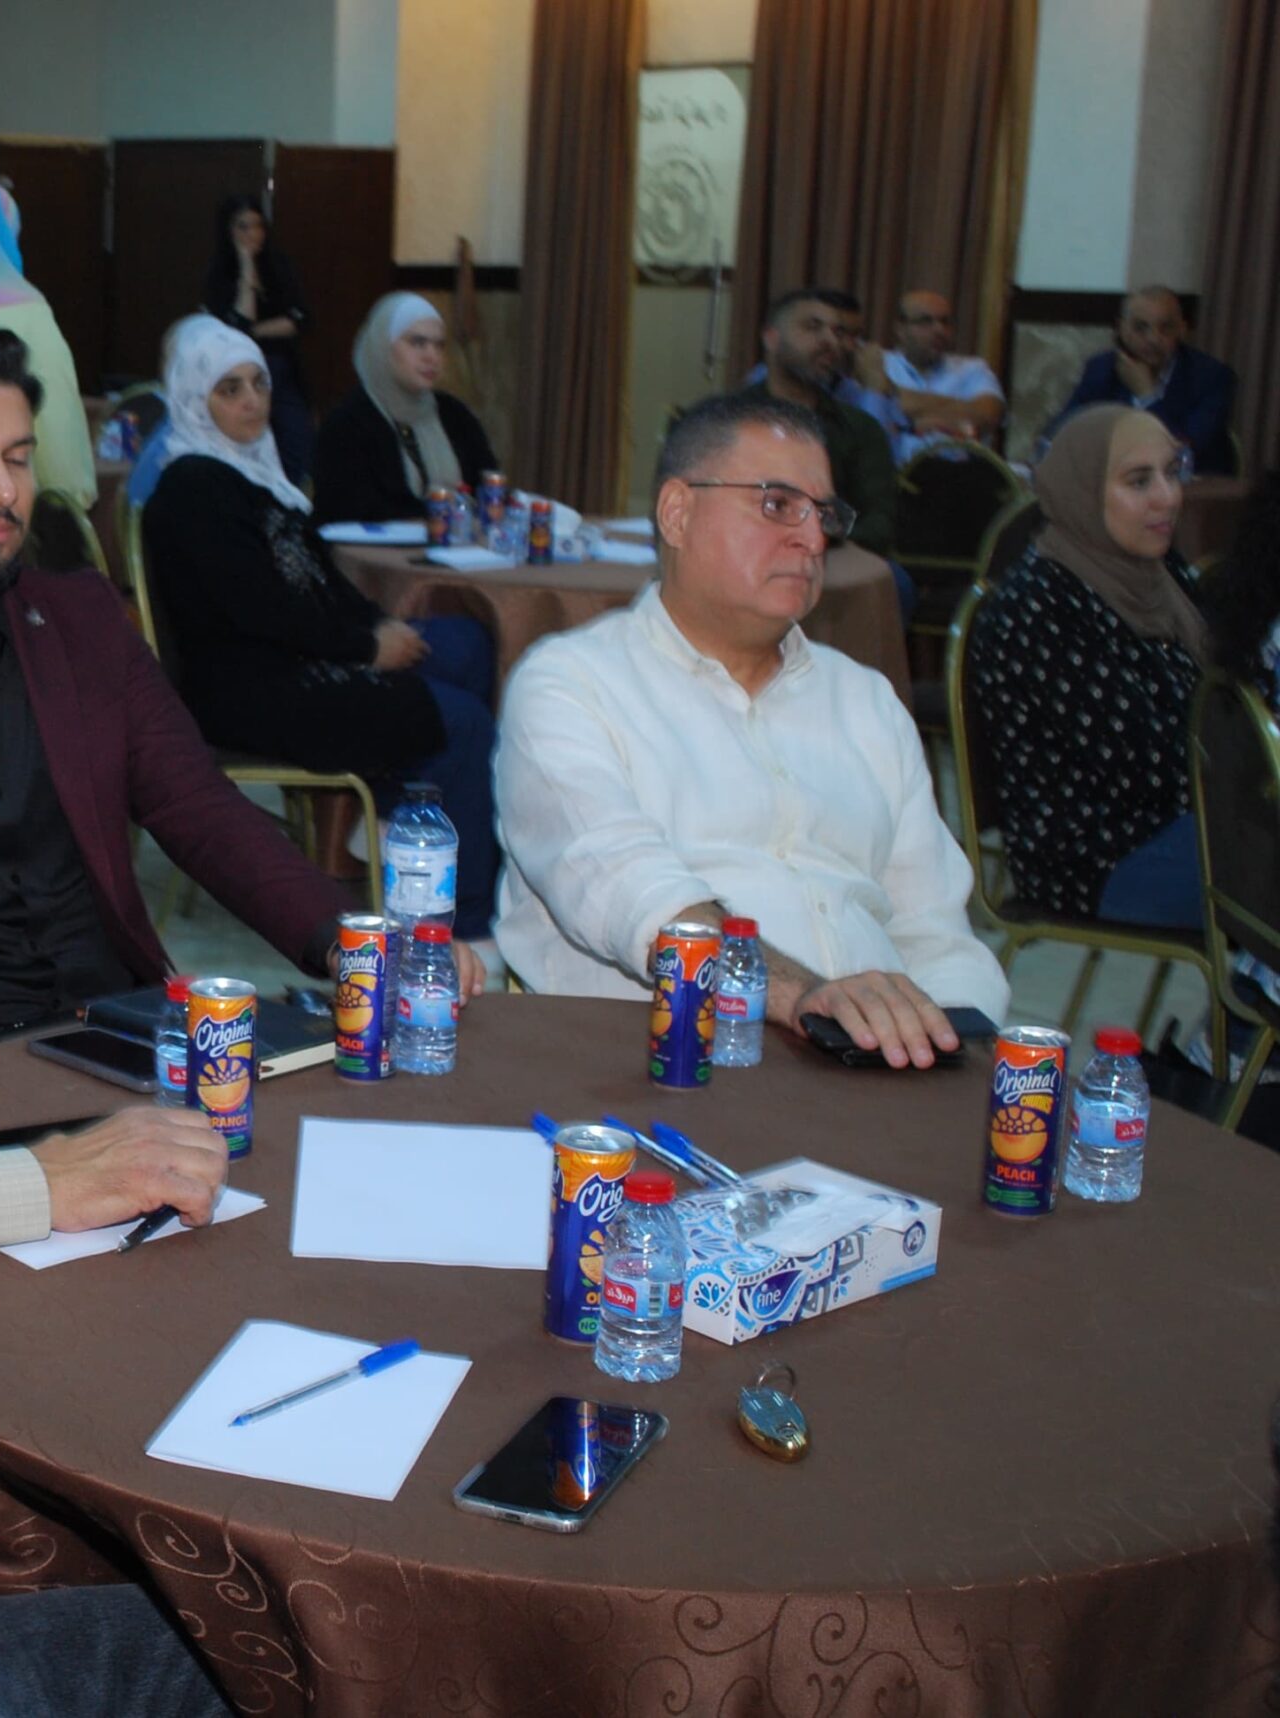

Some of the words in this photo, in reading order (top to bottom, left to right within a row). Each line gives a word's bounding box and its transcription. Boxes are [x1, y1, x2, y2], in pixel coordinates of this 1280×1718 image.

[339, 951, 380, 982] riginal
[196, 1018, 253, 1058] Original
[994, 1066, 1058, 1104] Original
[209, 1114, 247, 1128] RANGE
[996, 1164, 1036, 1182] PEACH
[579, 1182, 624, 1223] Orig
[756, 1283, 781, 1310] fine
[580, 1321, 598, 1331] NO
